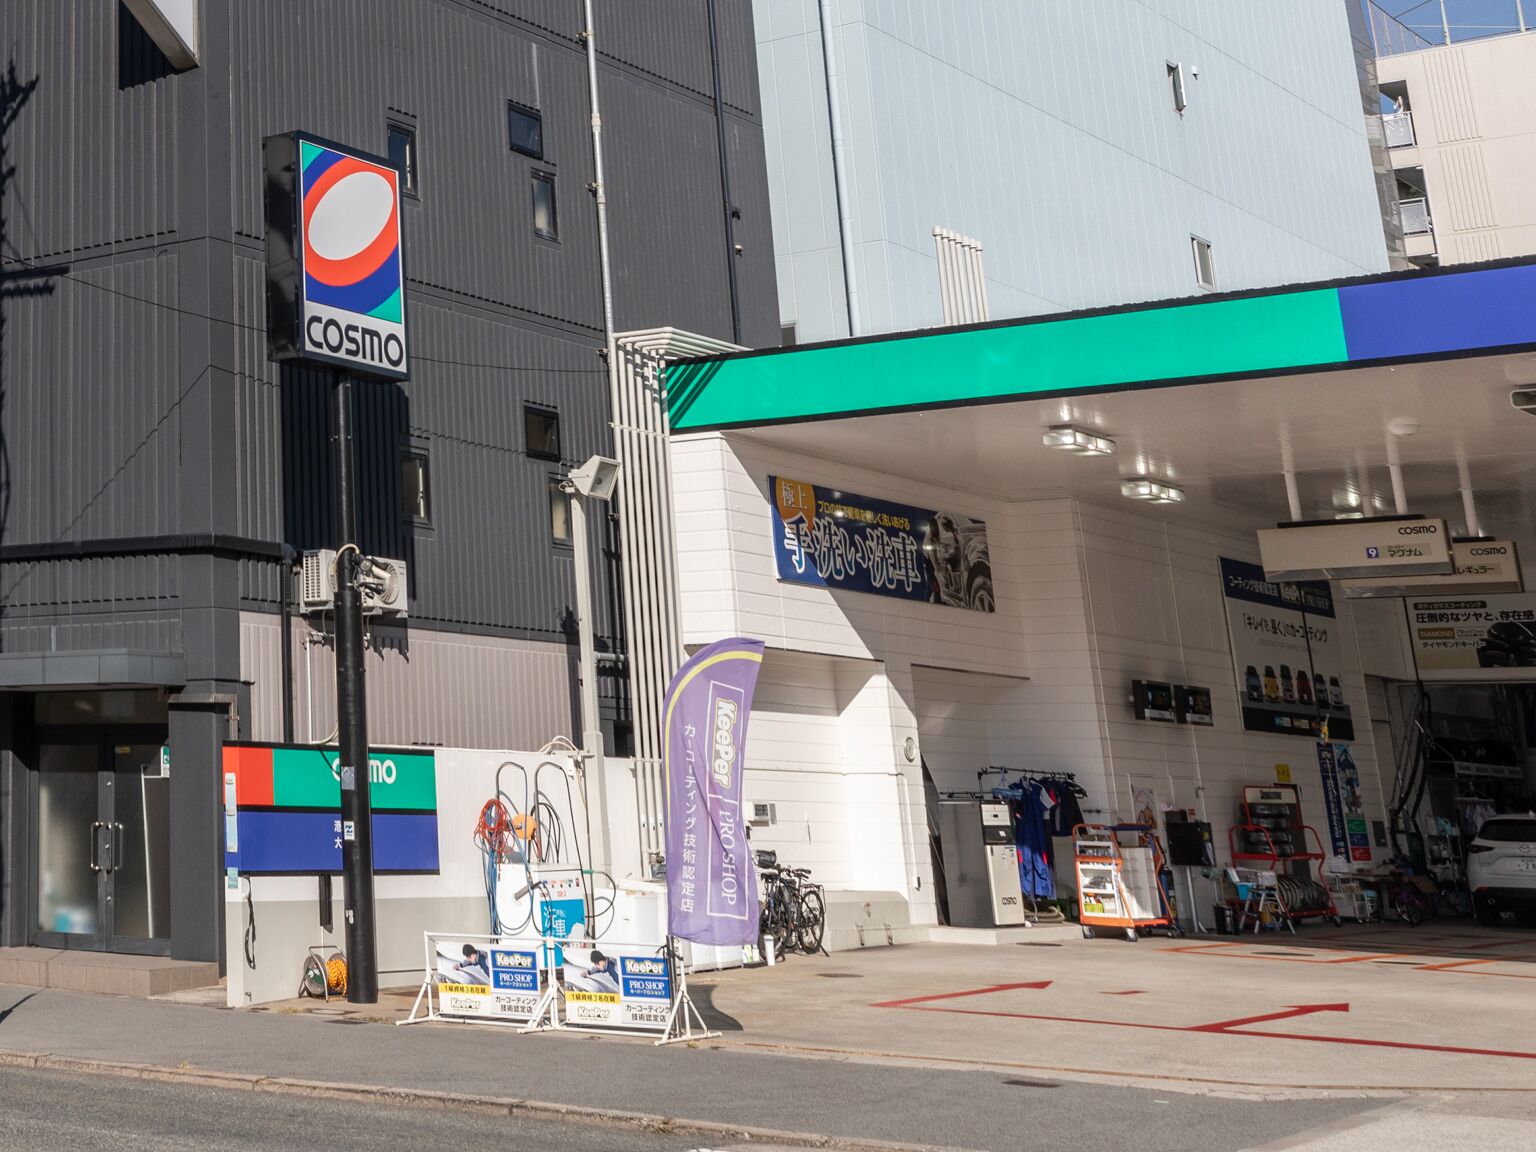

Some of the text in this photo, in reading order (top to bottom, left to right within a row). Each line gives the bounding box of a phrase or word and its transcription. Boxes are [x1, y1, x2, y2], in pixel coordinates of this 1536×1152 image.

[306, 315, 404, 368] COSMO
[1398, 525, 1437, 535] COSMO
[784, 512, 921, 592] 手洗い洗車
[1470, 547, 1507, 556] COSMO
[1456, 565, 1495, 575] レギュラー
[712, 698, 738, 789] KeePer
[719, 810, 738, 905] PRO SHOP
[495, 952, 533, 968] KeePer
[625, 959, 665, 975] KeePer
[499, 973, 533, 983] PRO SHOP
[629, 980, 665, 991] PRO SHOP
